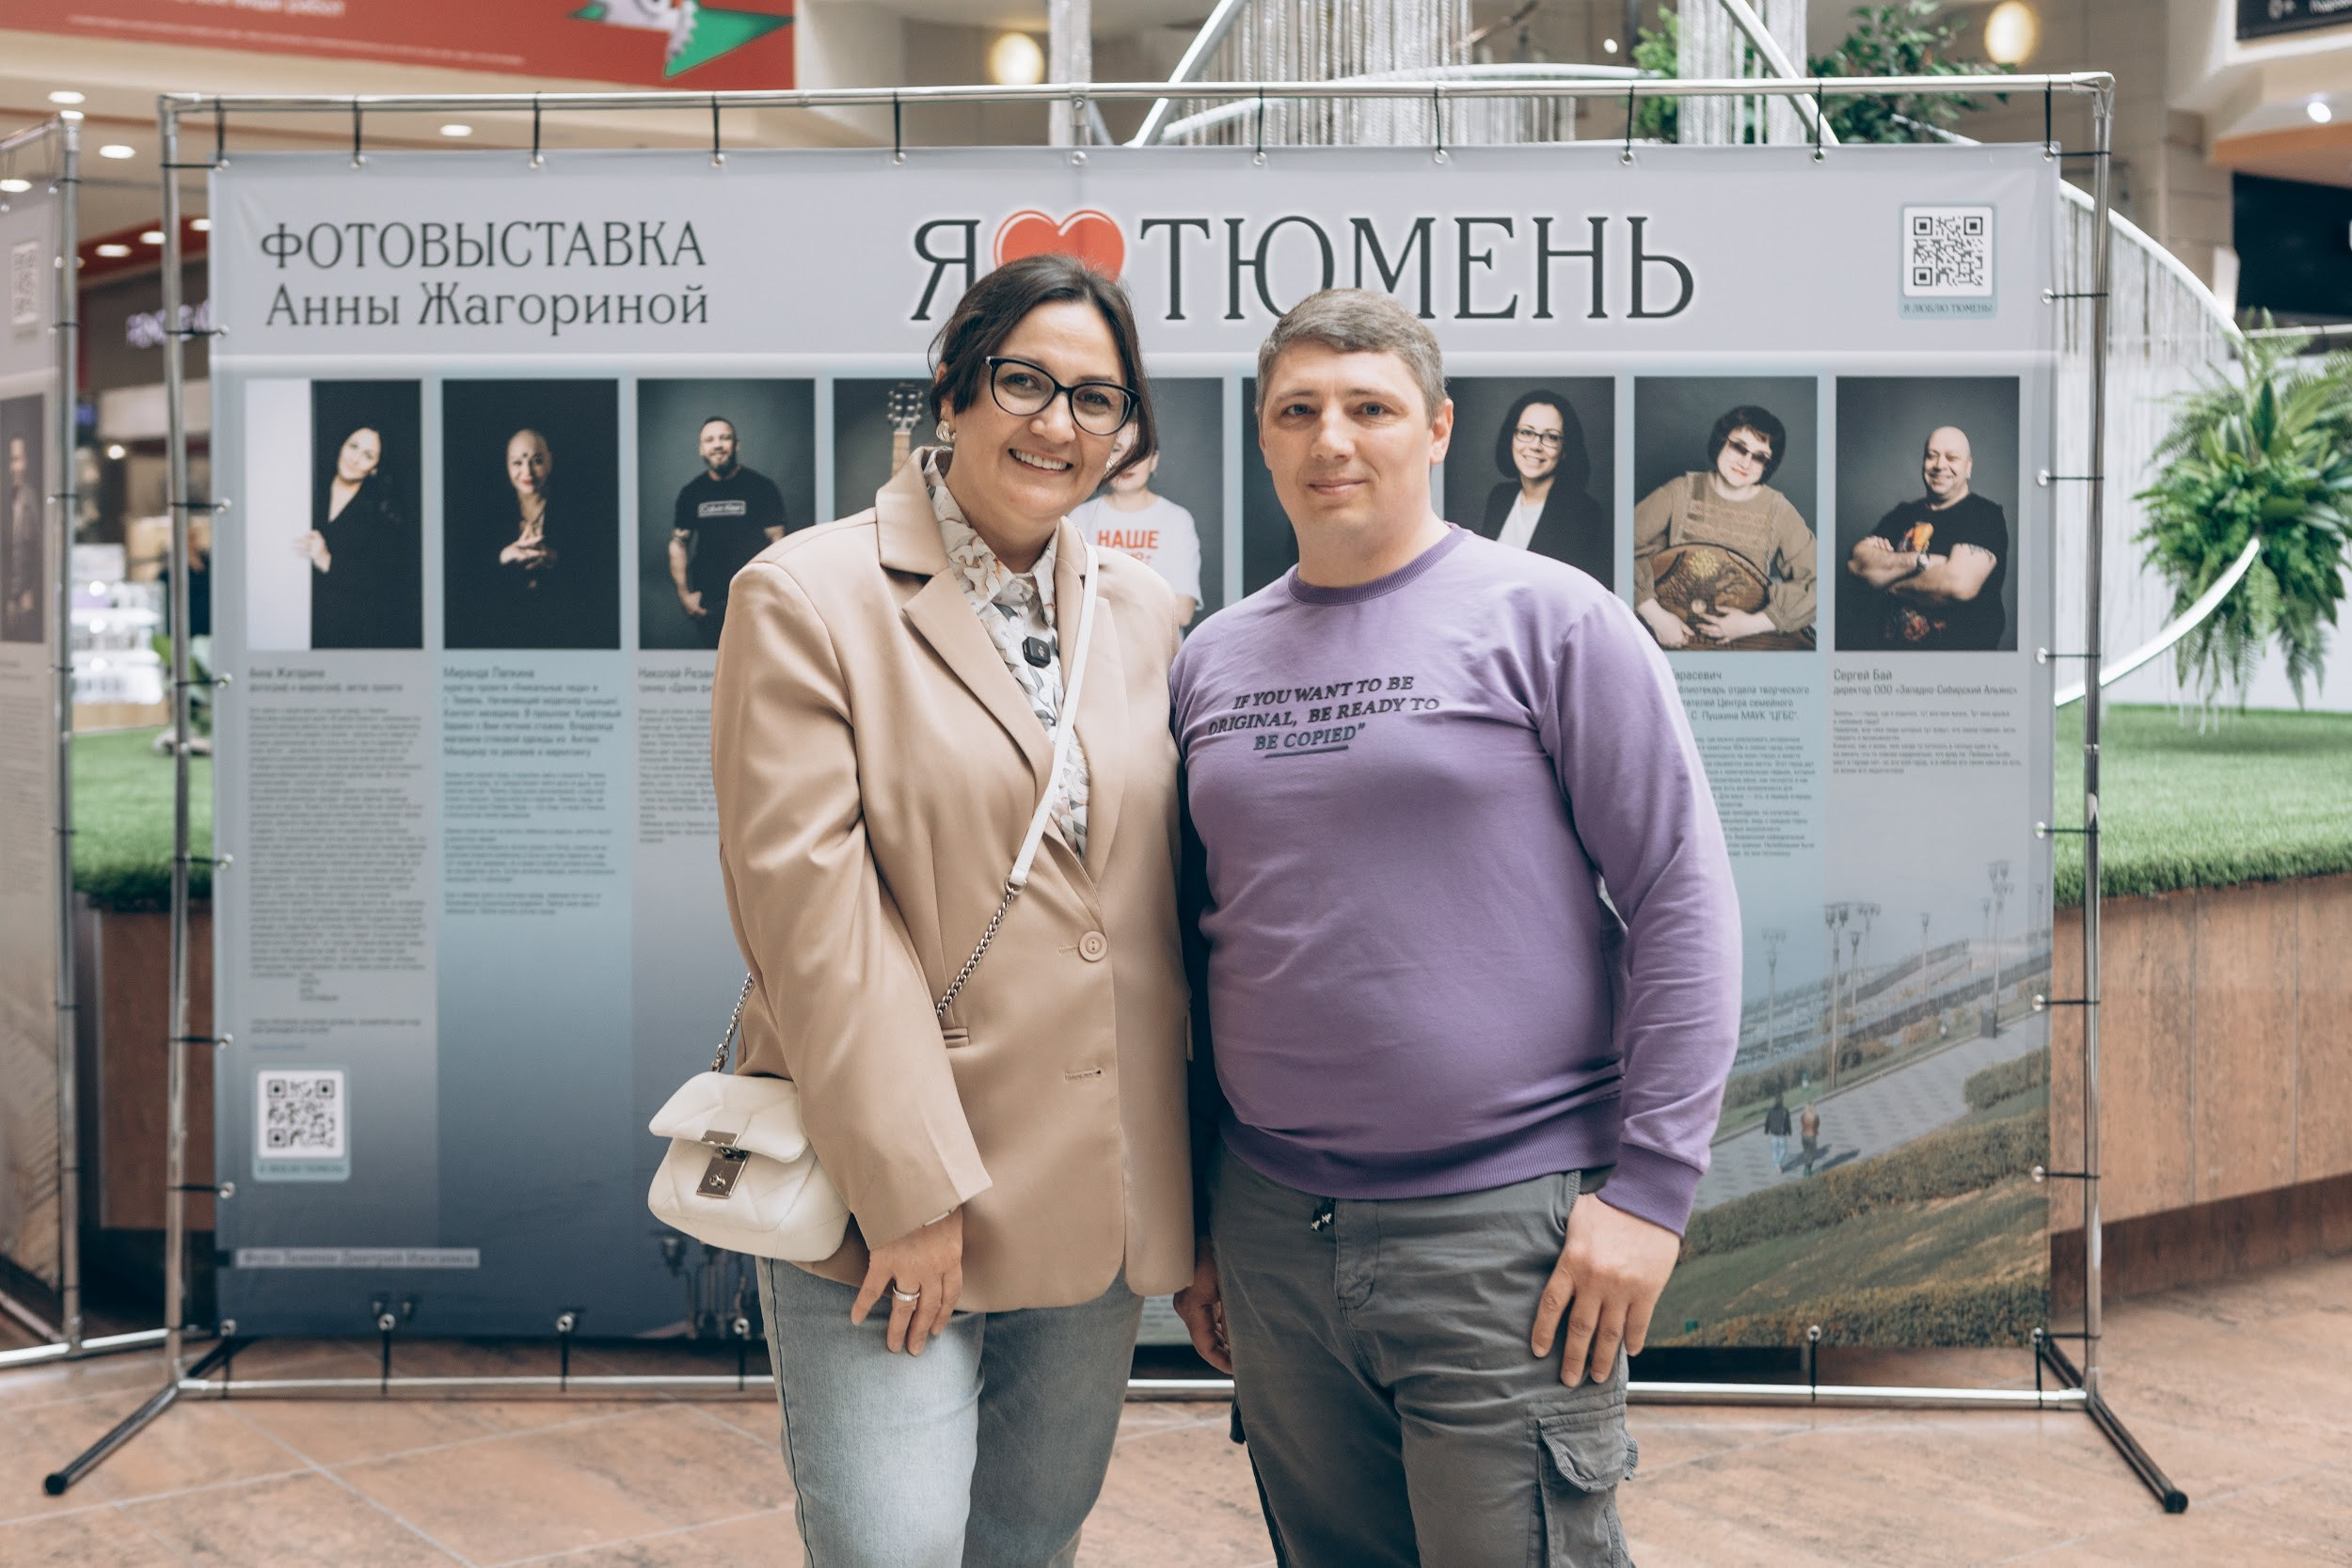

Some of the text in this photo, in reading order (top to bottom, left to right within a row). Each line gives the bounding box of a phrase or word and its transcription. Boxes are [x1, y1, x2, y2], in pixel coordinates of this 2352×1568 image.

[261, 221, 707, 270] ФОТОВЫСТАВКА
[910, 215, 1694, 321] Я ТЮМЕНЬ
[265, 283, 400, 325] Анны
[418, 282, 708, 336] Жагориной
[1098, 530, 1159, 549] НАШЕ
[1834, 668, 1893, 683] Сергей Бай
[1232, 675, 1414, 710] IF YOU WANT TO BE
[1678, 686, 1810, 697] блиотекарь отдела творческого
[1833, 686, 1872, 696] директор
[1873, 684, 1893, 694] ООО
[1682, 697, 1793, 708] тателей Центра семейного
[1208, 697, 1440, 736] ORIGINAL, BE READY TO
[1702, 710, 1739, 721] Пушкина
[1740, 710, 1766, 721] МАУК
[1253, 735, 1279, 752] BE
